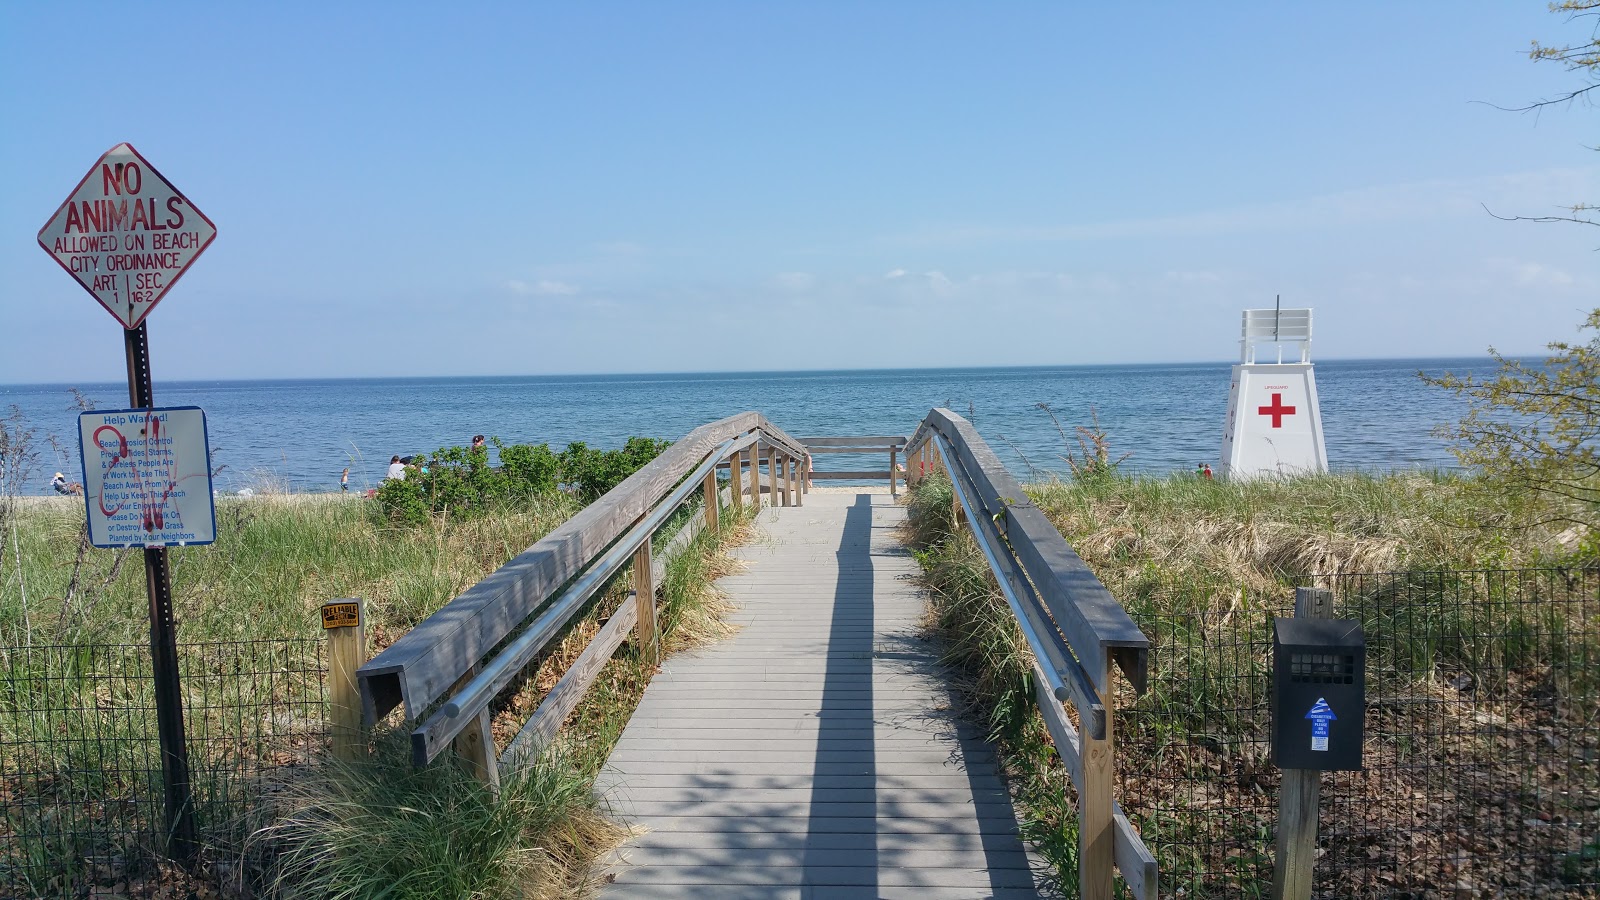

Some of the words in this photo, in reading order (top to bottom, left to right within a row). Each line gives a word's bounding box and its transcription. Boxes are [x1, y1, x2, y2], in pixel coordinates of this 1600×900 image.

[102, 161, 142, 196] NO
[64, 196, 185, 234] ANIMALS
[54, 235, 118, 254] ALLOWED
[124, 234, 145, 251] ON
[153, 232, 199, 250] BEACH
[70, 255, 100, 273] CITY
[106, 252, 181, 271] ORDINANCE
[113, 292, 119, 304] 1
[131, 290, 153, 303] 16-2
[103, 415, 126, 426] Help
[100, 439, 120, 448] Beach
[148, 437, 173, 446] Control
[148, 447, 174, 457] Storms,
[101, 461, 107, 469] &
[108, 460, 137, 469] Careless
[138, 459, 160, 468] People
[162, 458, 174, 466] Are
[102, 472, 109, 480] at
[110, 471, 127, 479] Work
[128, 470, 135, 478] to
[136, 469, 152, 478] Take
[154, 469, 169, 477] This
[103, 482, 124, 490] Beach
[125, 481, 143, 491] Away
[145, 480, 162, 488] From
[104, 492, 120, 502] Help
[120, 491, 130, 500] Us
[131, 491, 148, 501] Keep
[150, 490, 163, 499] This
[165, 490, 186, 498] Beach
[105, 502, 115, 510] for
[116, 501, 132, 511] Your
[107, 512, 128, 521] Please
[129, 512, 139, 521] Do
[170, 510, 180, 519] On
[116, 523, 140, 533] Destroy
[164, 521, 184, 531] Grass
[108, 533, 133, 542] Planted
[134, 533, 142, 543] by
[143, 532, 160, 541] Your
[160, 531, 195, 542] Neighbors
[324, 606, 356, 617] RELIABLE
